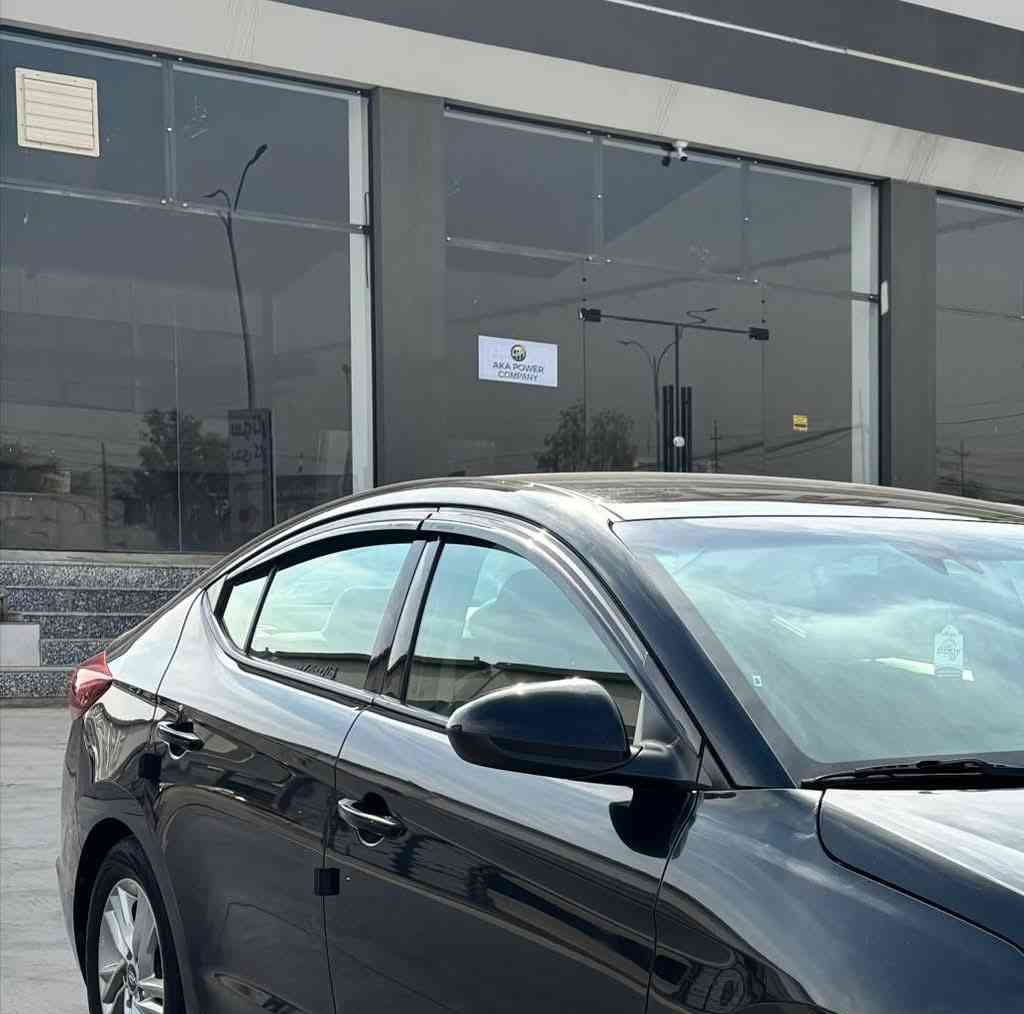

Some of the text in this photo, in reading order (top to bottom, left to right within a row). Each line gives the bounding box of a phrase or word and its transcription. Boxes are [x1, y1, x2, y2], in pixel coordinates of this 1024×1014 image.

[492, 361, 544, 375] AKA POWER
[497, 370, 538, 382] COMPANY
